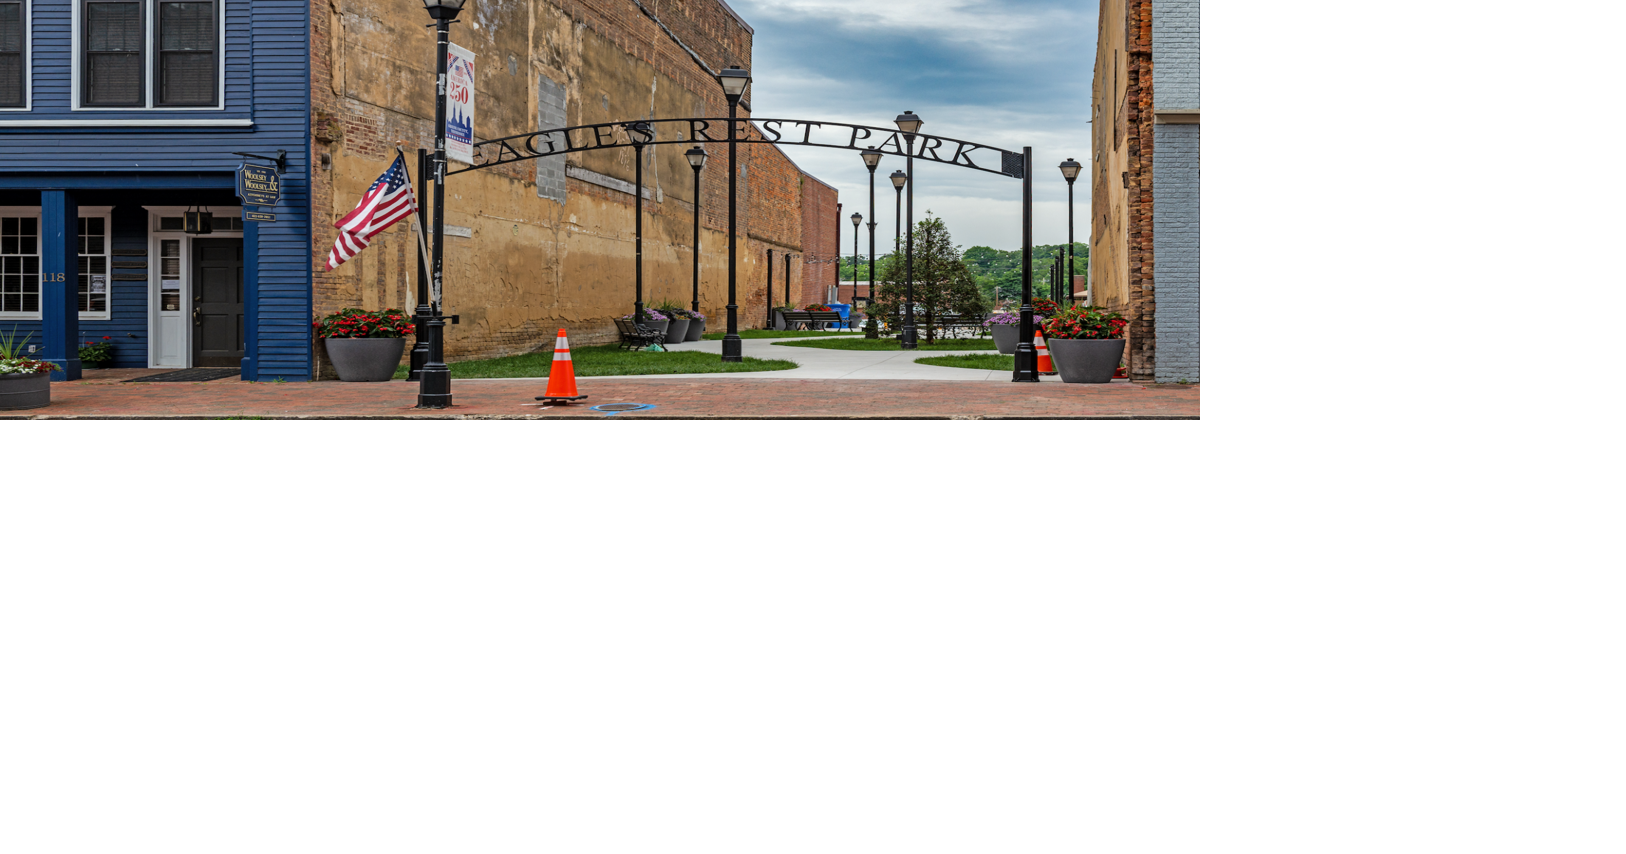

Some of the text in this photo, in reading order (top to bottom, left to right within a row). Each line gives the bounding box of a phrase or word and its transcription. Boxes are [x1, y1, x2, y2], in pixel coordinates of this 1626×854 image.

[450, 82, 468, 104] 250
[685, 119, 822, 145] REST
[848, 126, 980, 169] PARK
[270, 176, 278, 191] &
[42, 272, 65, 282] 118
